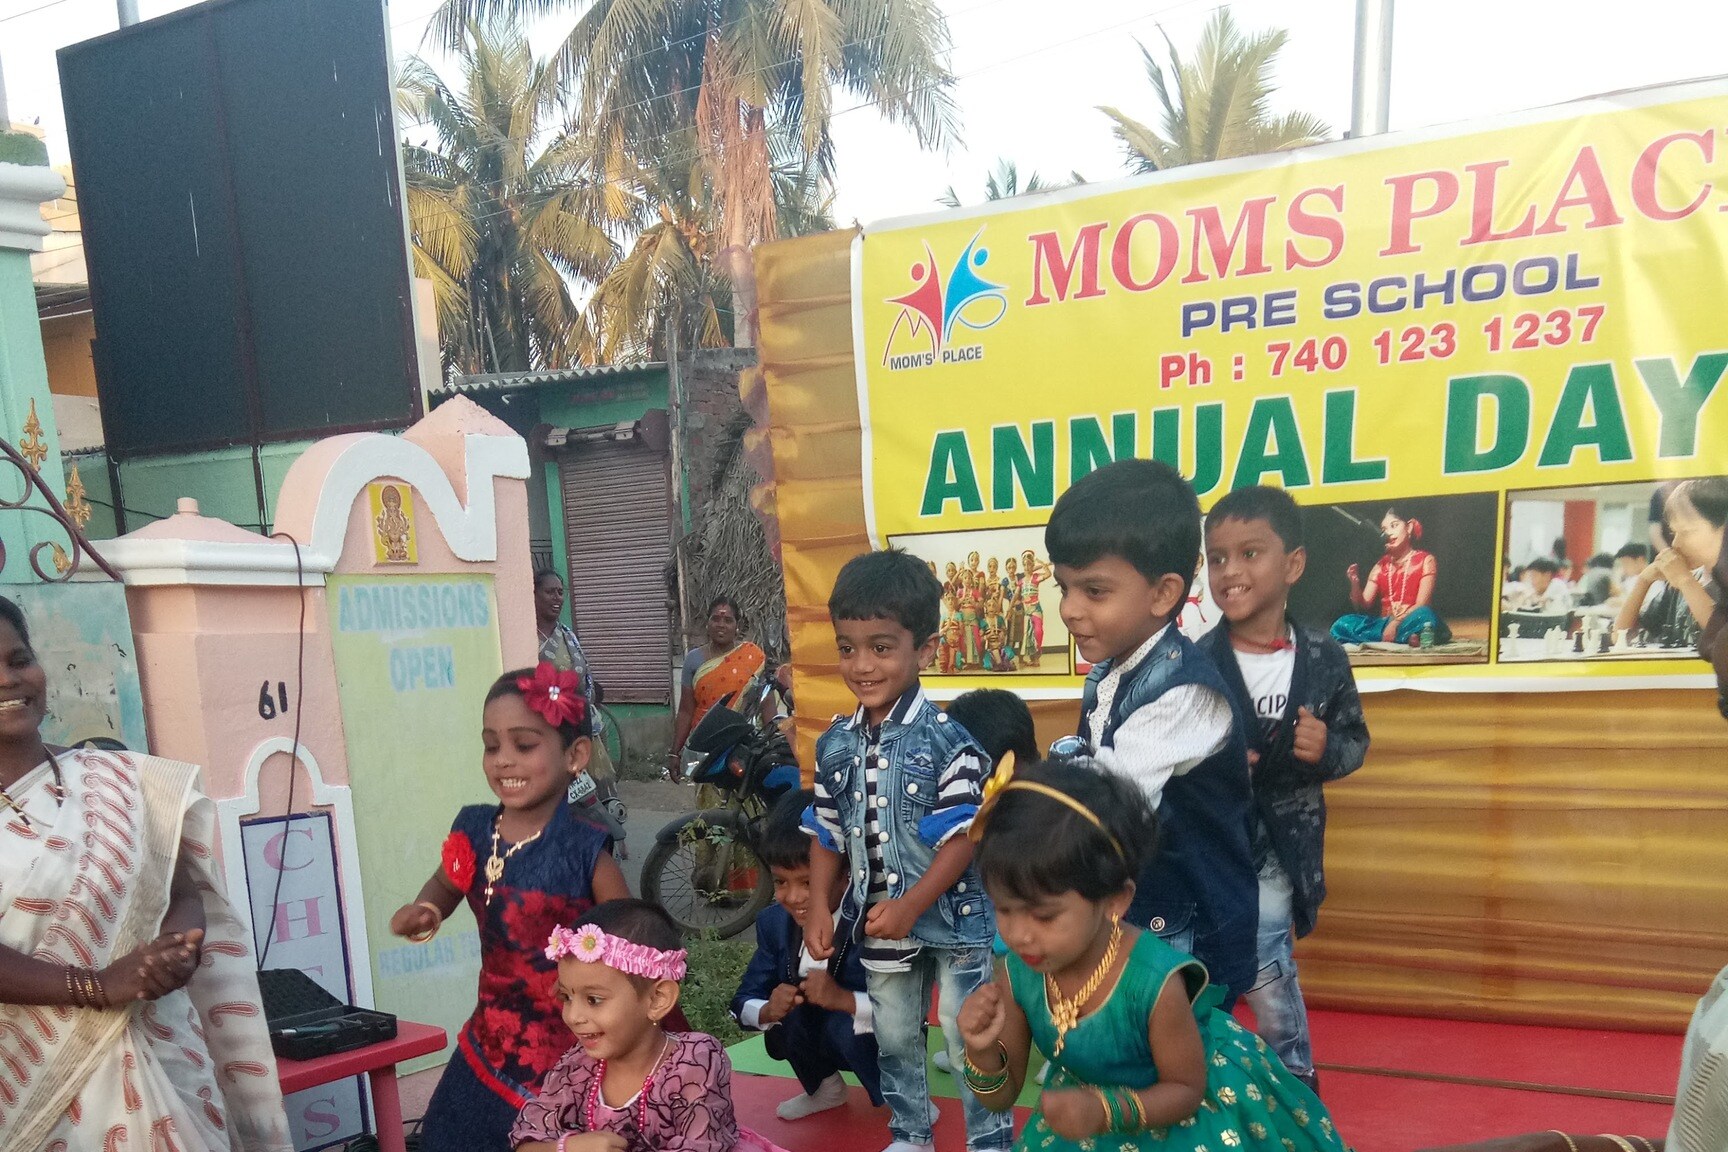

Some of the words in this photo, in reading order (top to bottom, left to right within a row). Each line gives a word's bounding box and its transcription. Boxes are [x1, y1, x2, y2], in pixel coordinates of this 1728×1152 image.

[1025, 186, 1346, 306] MOMS
[1379, 127, 1728, 257] PLAC
[1181, 290, 1298, 338] PRE
[1323, 253, 1600, 320] SCHOOL
[890, 353, 933, 371] MOM'S
[943, 346, 982, 363] PLACE
[1160, 352, 1211, 388] Ph
[1267, 336, 1348, 377] 740
[1374, 322, 1457, 366] 123
[1485, 305, 1605, 352] 1237
[920, 389, 1387, 516] ANNUAL
[1442, 352, 1728, 474] DAY
[339, 583, 489, 632] ADMISSIONS
[258, 680, 288, 720] 61
[390, 645, 455, 692] OPEN
